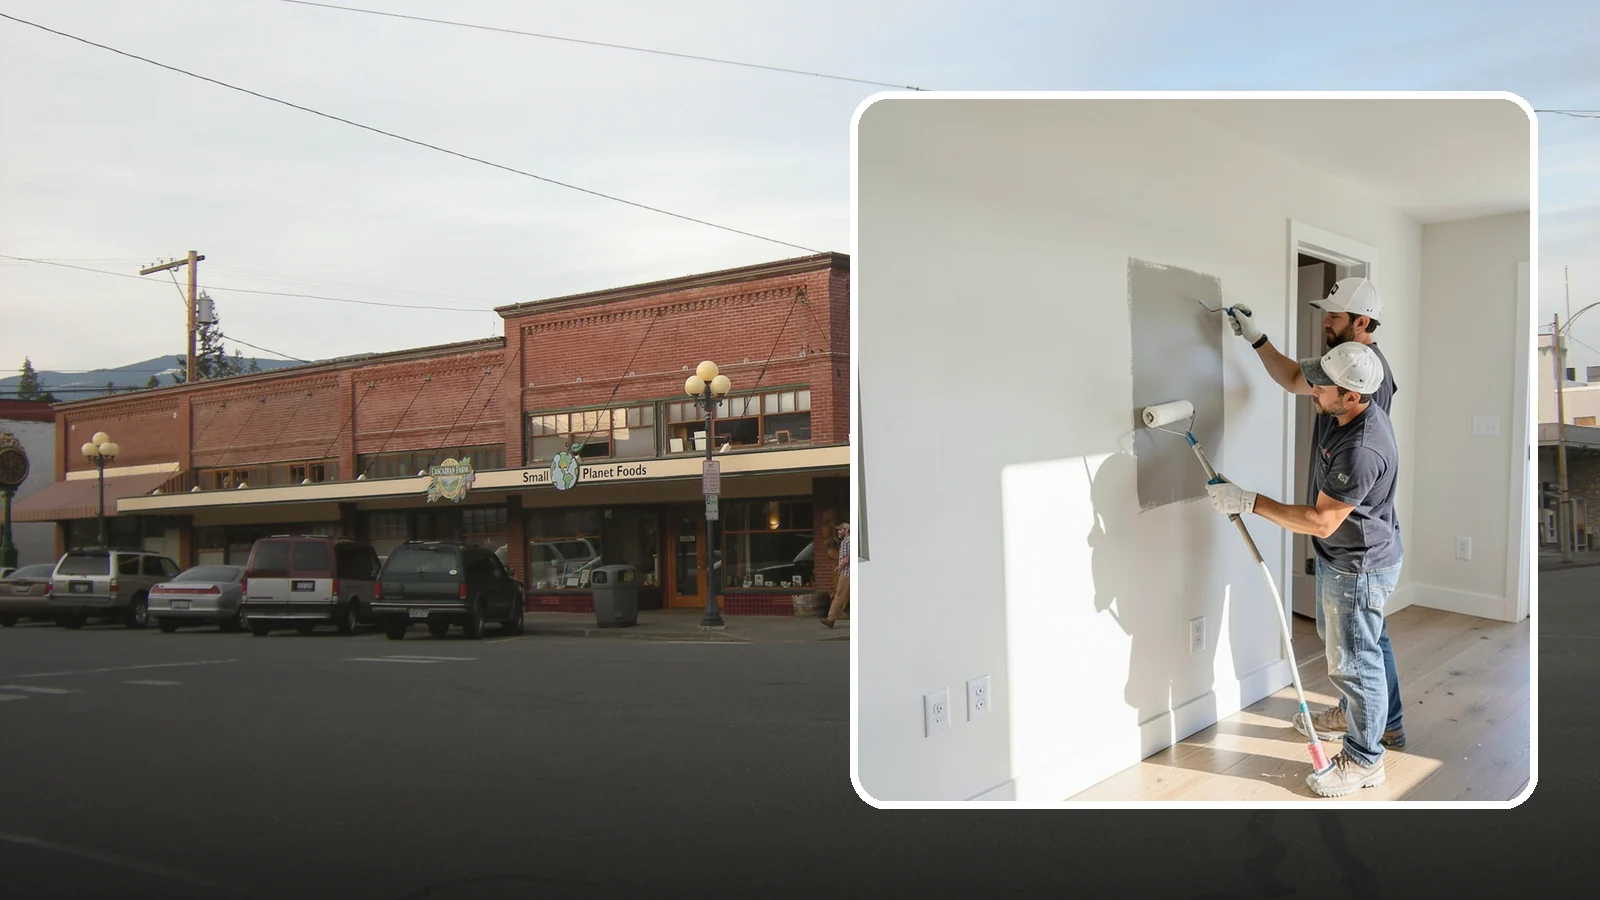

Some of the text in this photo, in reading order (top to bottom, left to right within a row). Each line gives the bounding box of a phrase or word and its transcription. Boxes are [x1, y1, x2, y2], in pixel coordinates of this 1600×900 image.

[523, 464, 647, 483] Small Planet Foods
